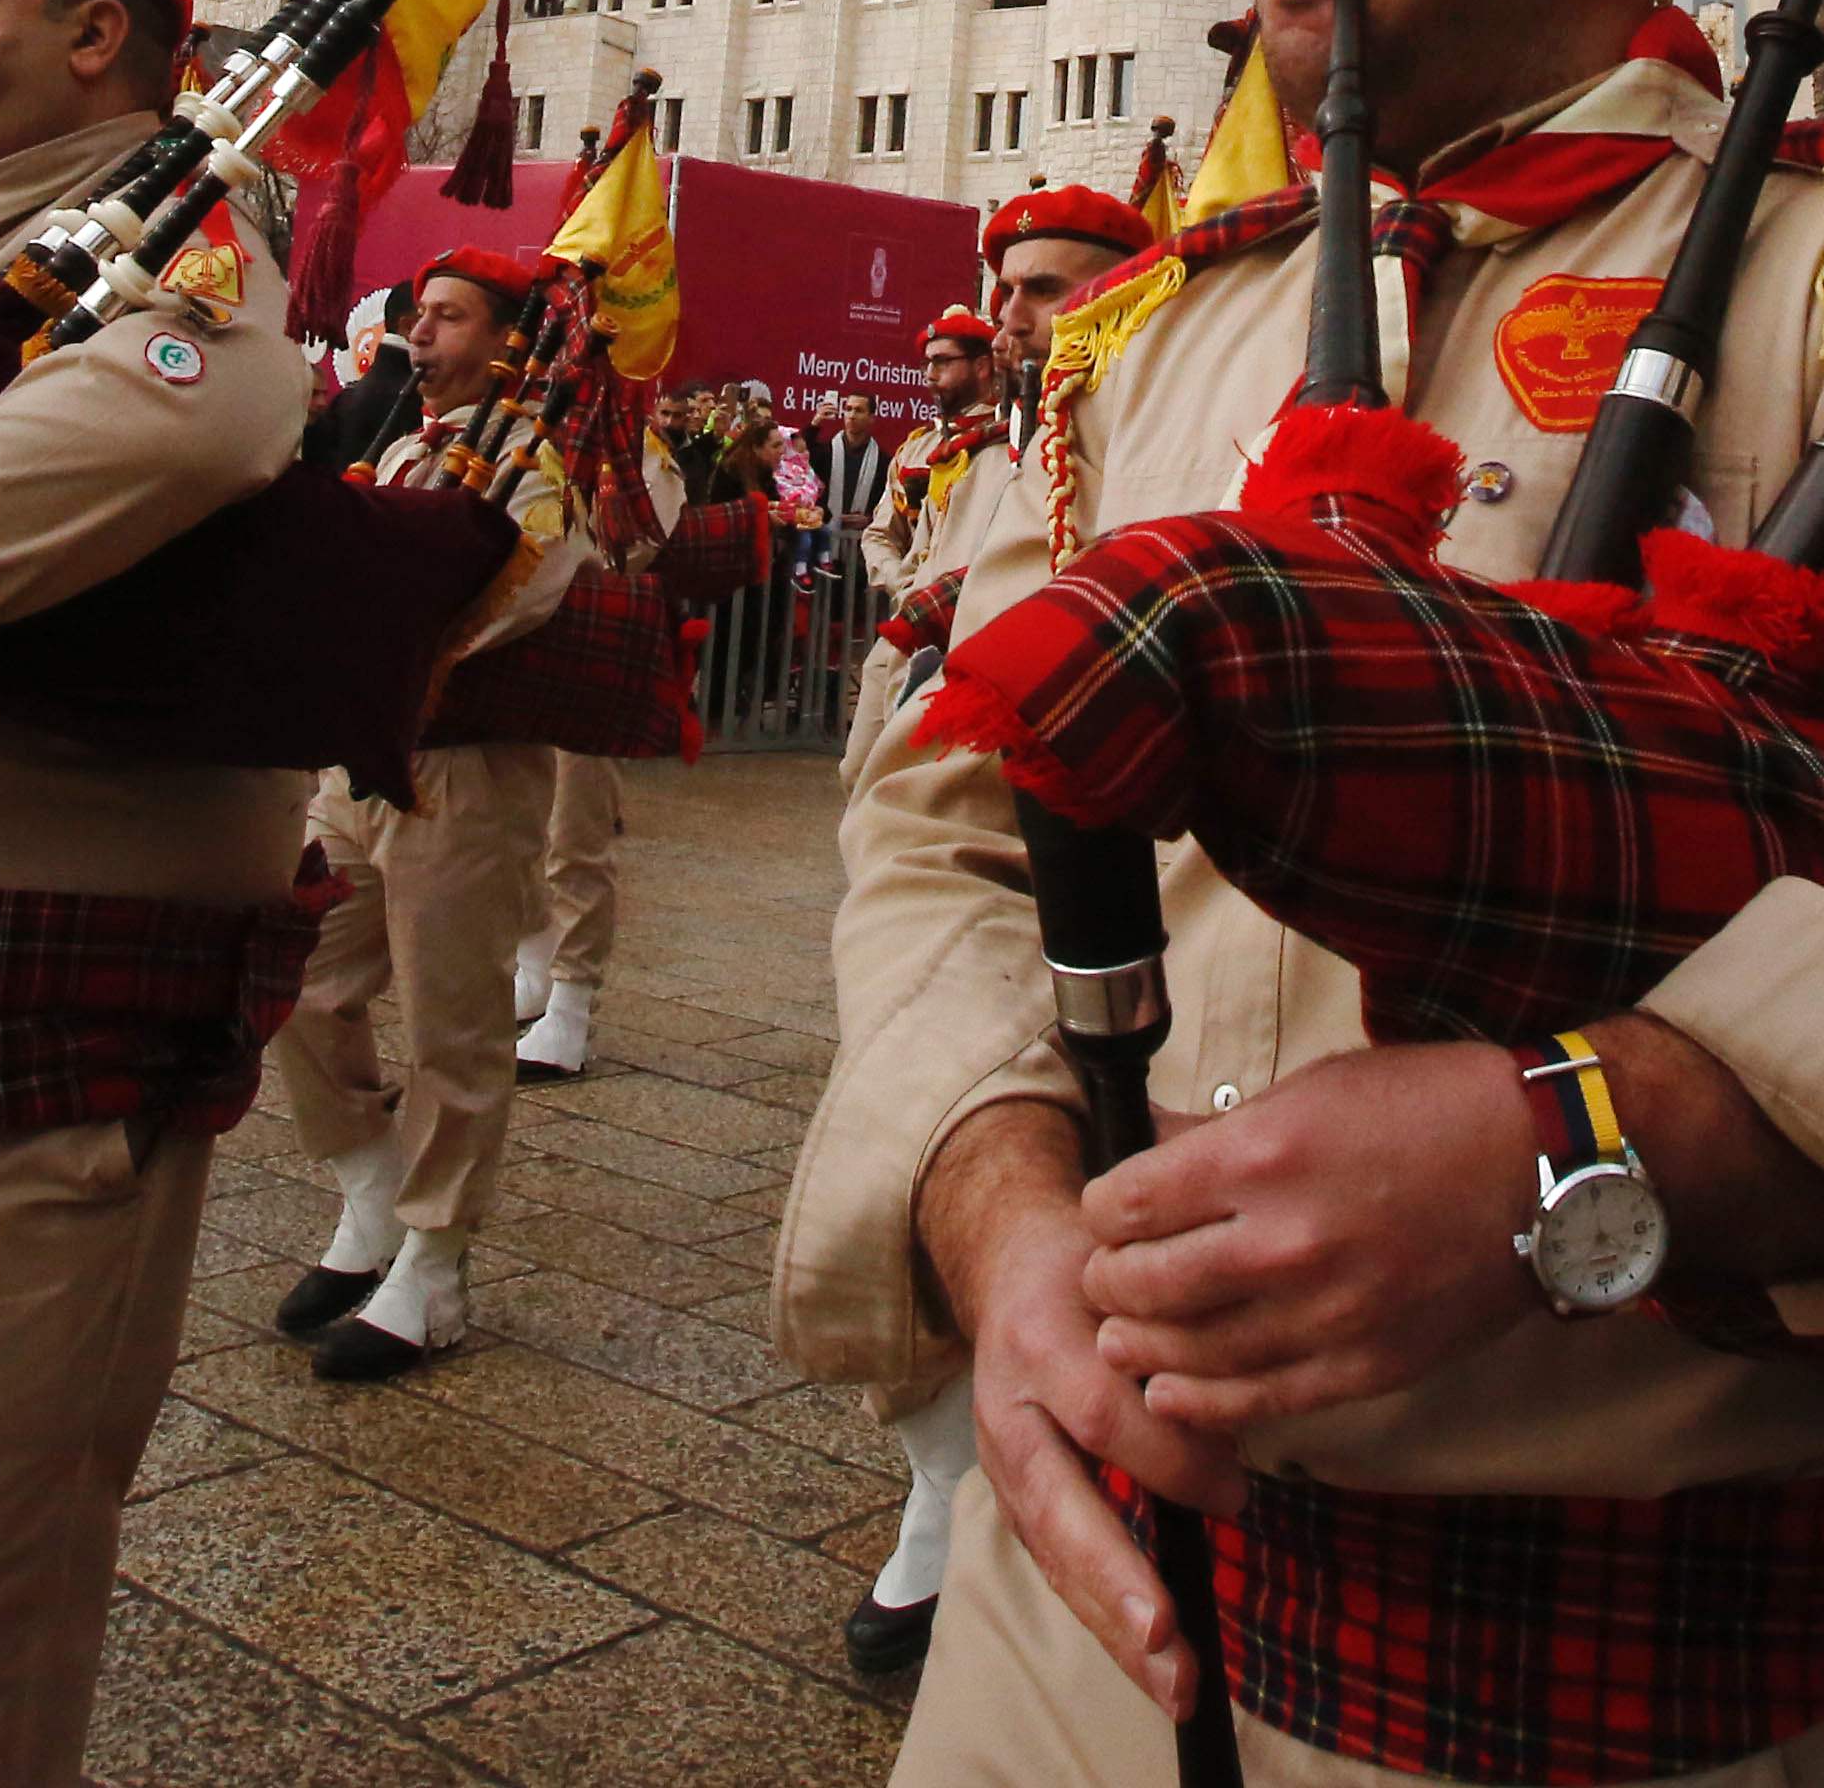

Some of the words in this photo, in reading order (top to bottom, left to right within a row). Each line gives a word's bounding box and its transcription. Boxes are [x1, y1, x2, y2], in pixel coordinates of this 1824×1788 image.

[798, 352, 851, 384] Merry
[855, 358, 930, 387] Christma
[783, 386, 796, 411] &
[909, 397, 939, 422] Yea
